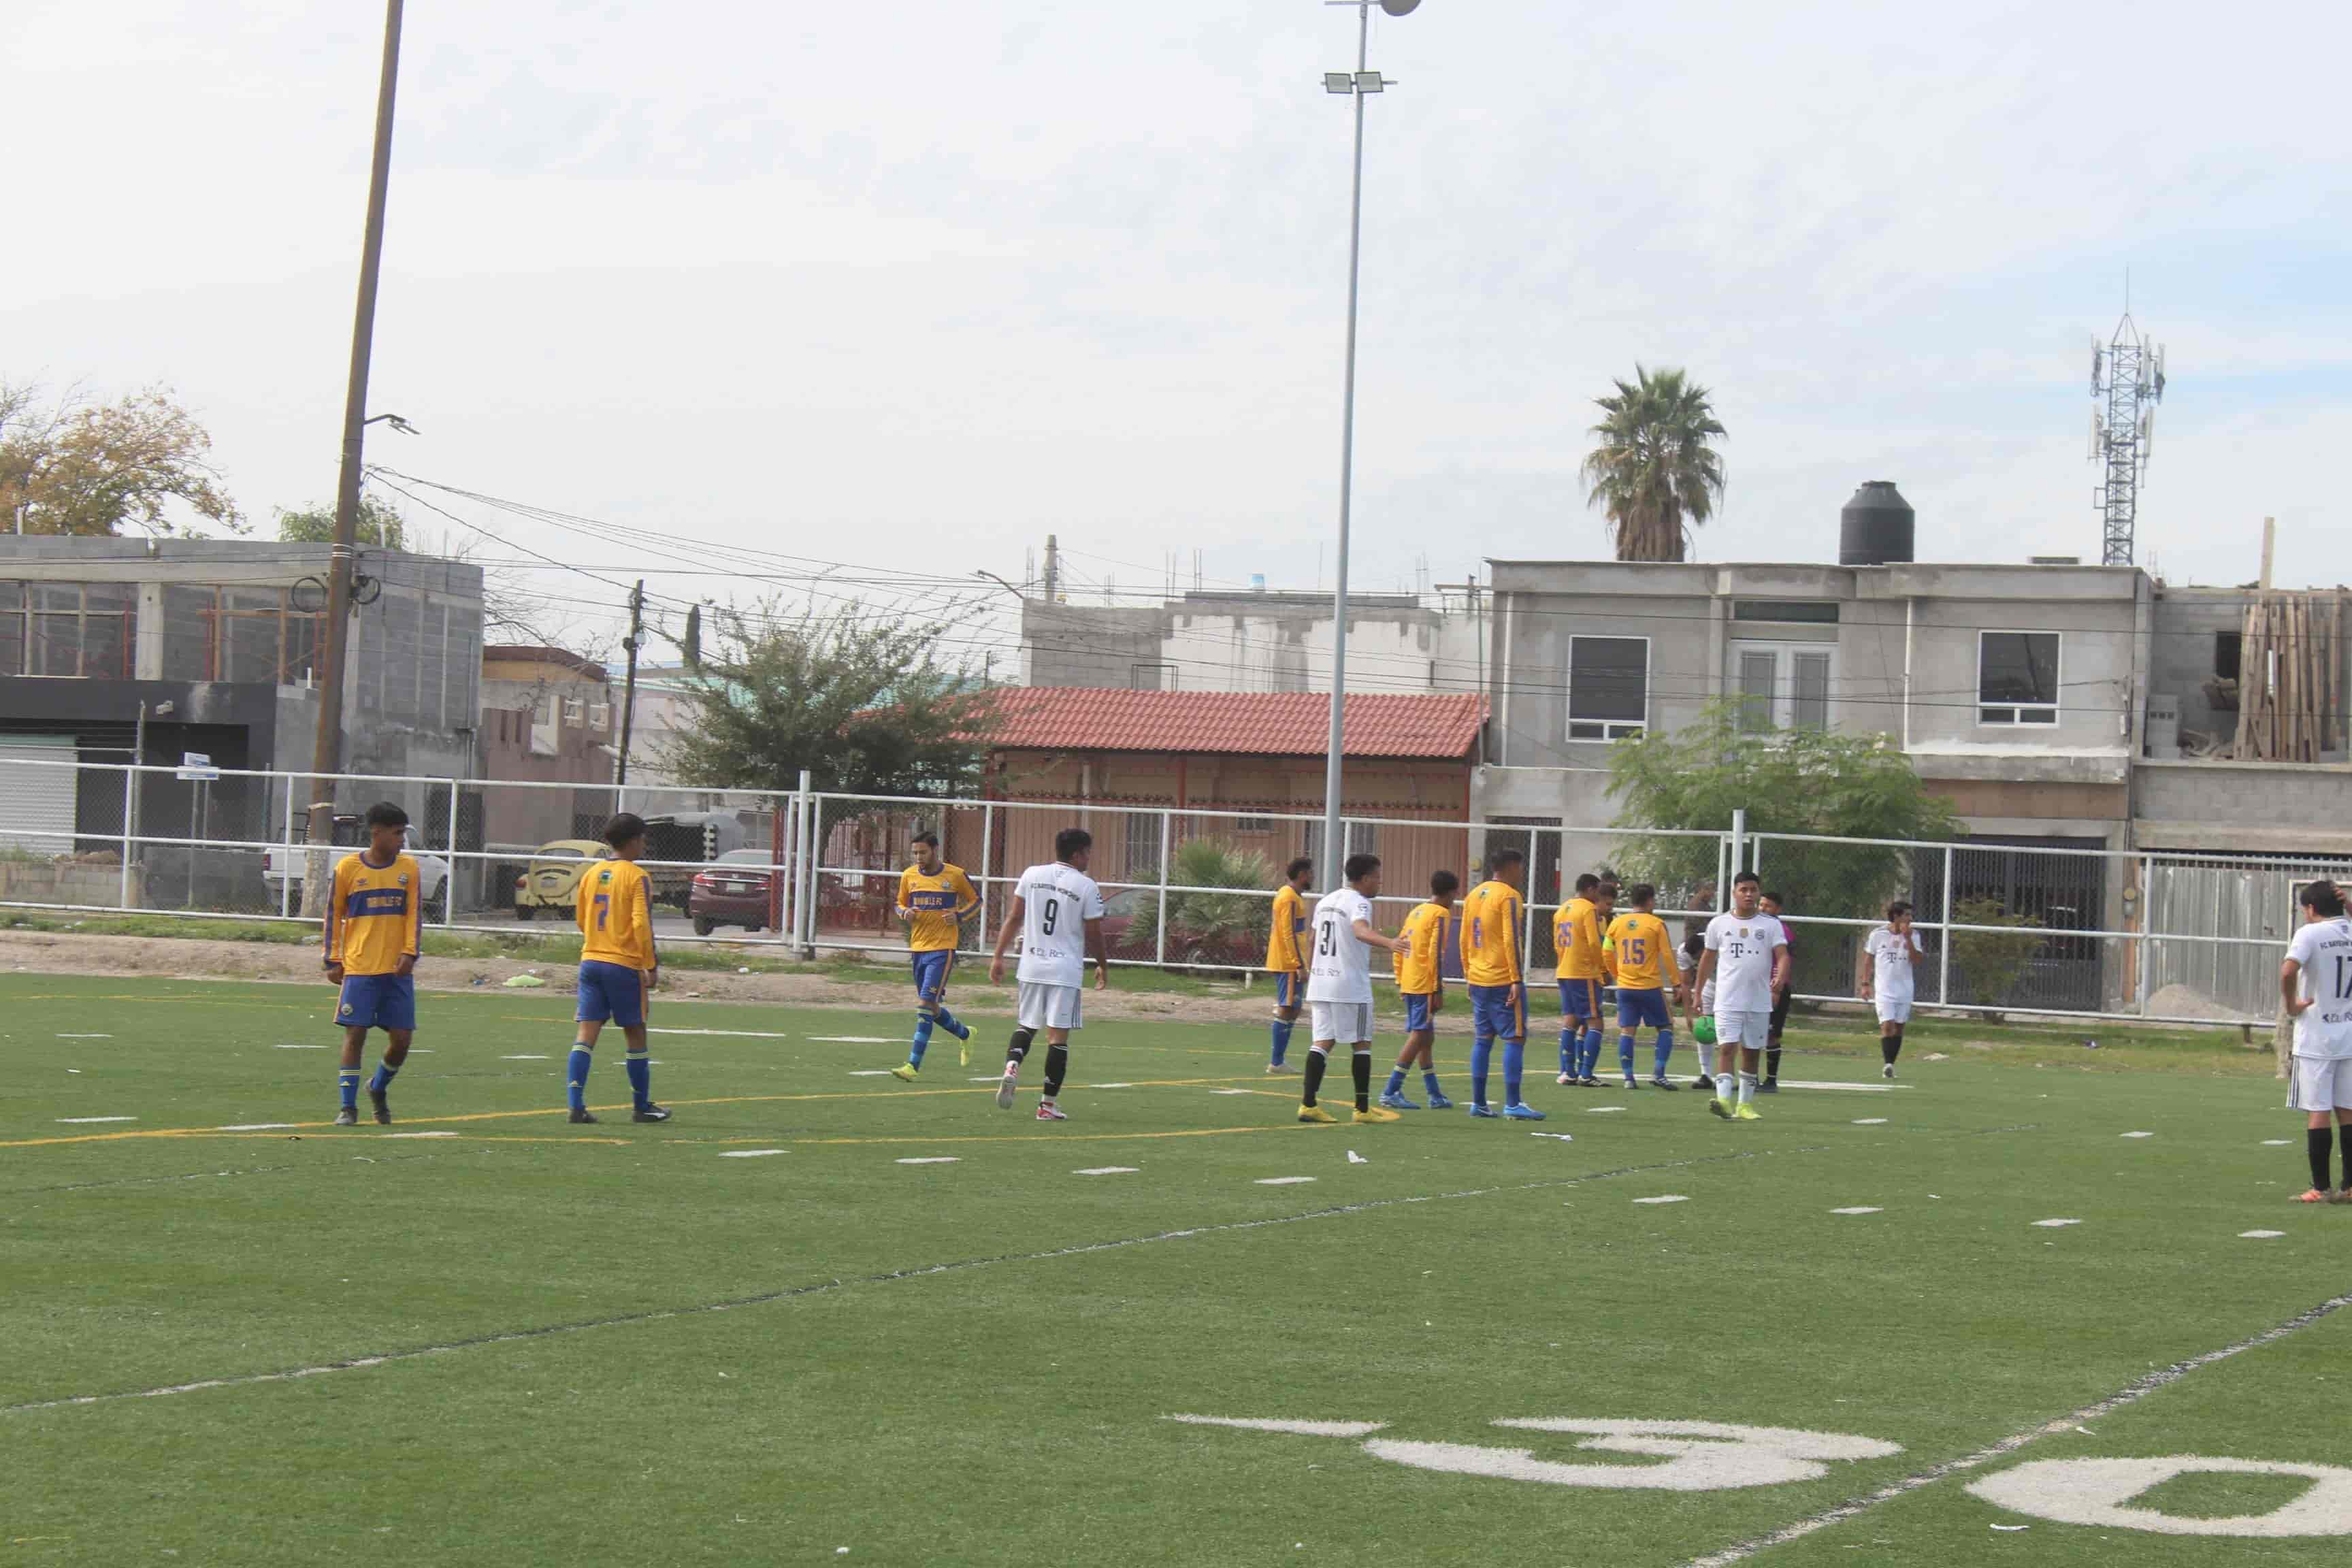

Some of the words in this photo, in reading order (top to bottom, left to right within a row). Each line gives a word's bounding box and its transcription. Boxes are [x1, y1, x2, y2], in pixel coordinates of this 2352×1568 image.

[594, 894, 610, 931] 7
[1043, 898, 1058, 936] 9
[1622, 938, 1646, 964] 15
